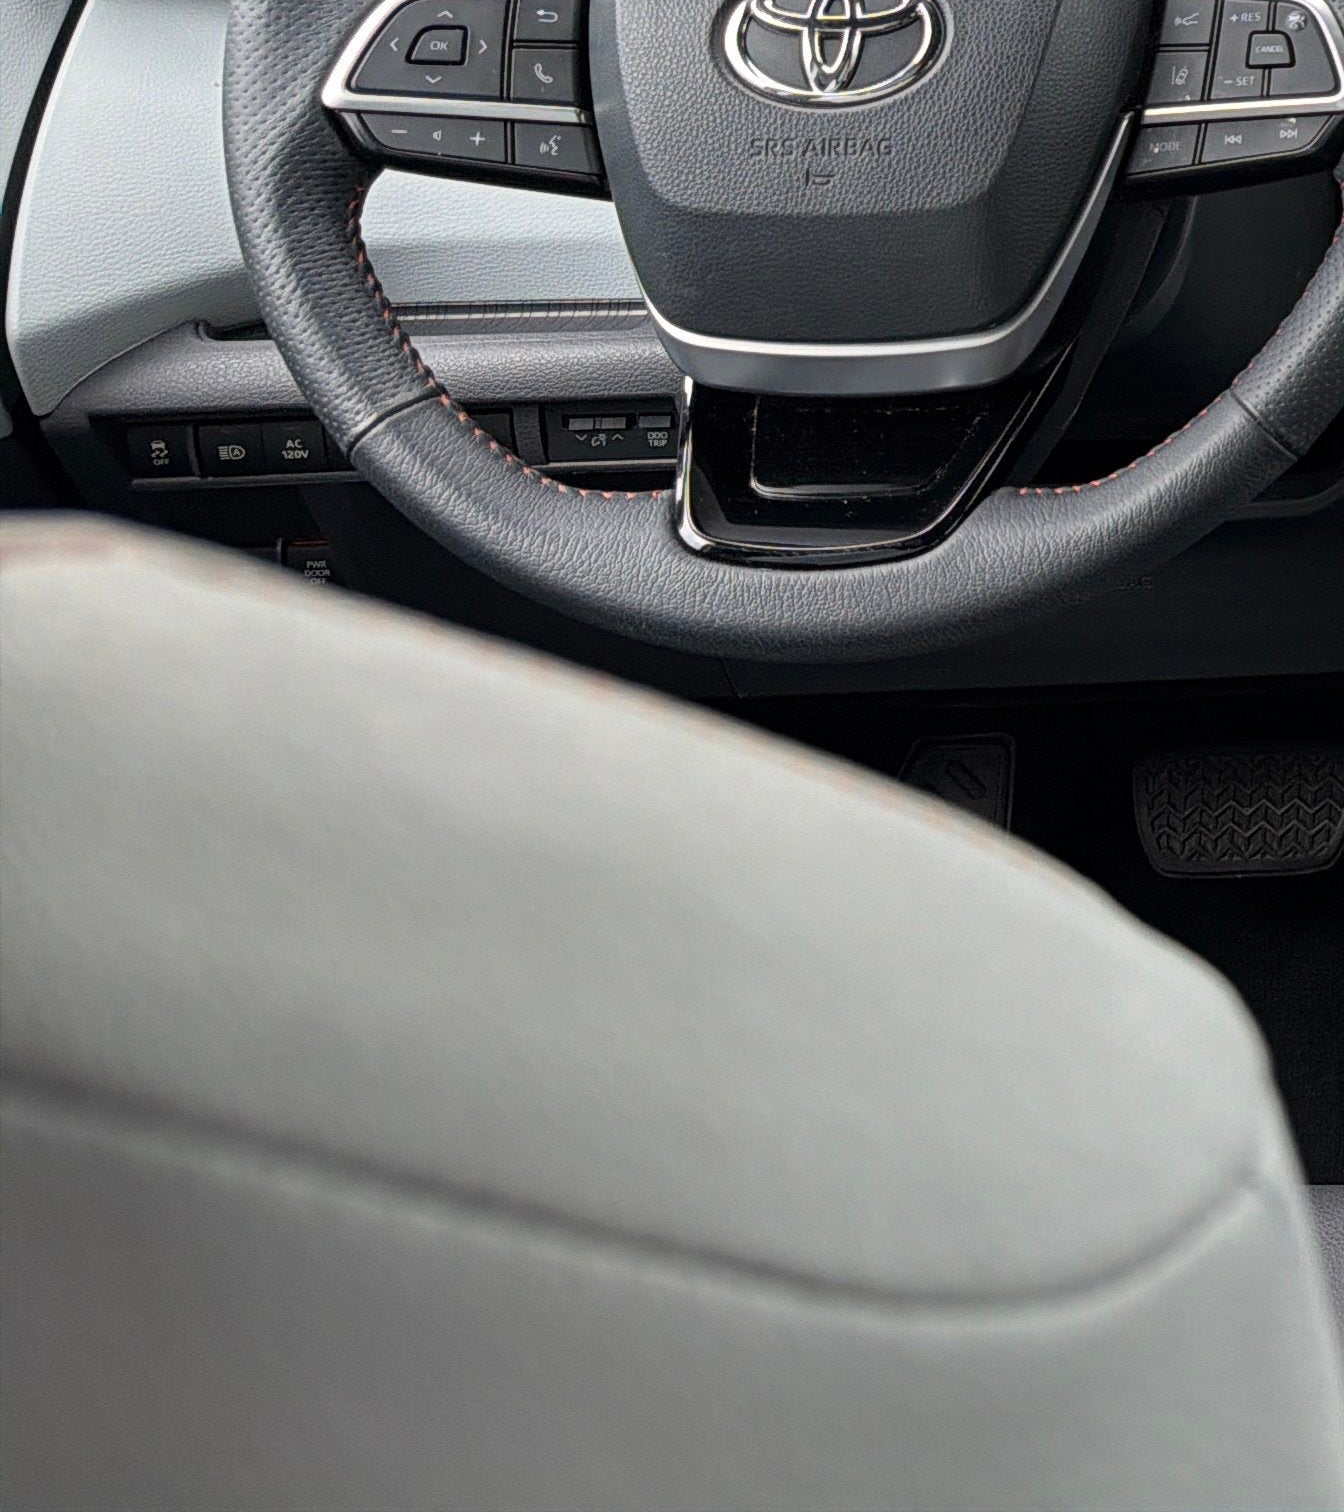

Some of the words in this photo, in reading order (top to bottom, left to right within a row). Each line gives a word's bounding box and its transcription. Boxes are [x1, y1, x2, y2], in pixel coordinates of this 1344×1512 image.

[430, 41, 448, 51] OK
[1255, 45, 1283, 53] CANCEL
[750, 138, 793, 157] SRS
[801, 138, 893, 157] AIRBAG
[1150, 141, 1181, 153] MODE
[286, 439, 303, 448] AC
[282, 450, 309, 459] 120V
[153, 458, 169, 466] OFF
[306, 560, 326, 568] PWR
[304, 569, 330, 577] DOOR
